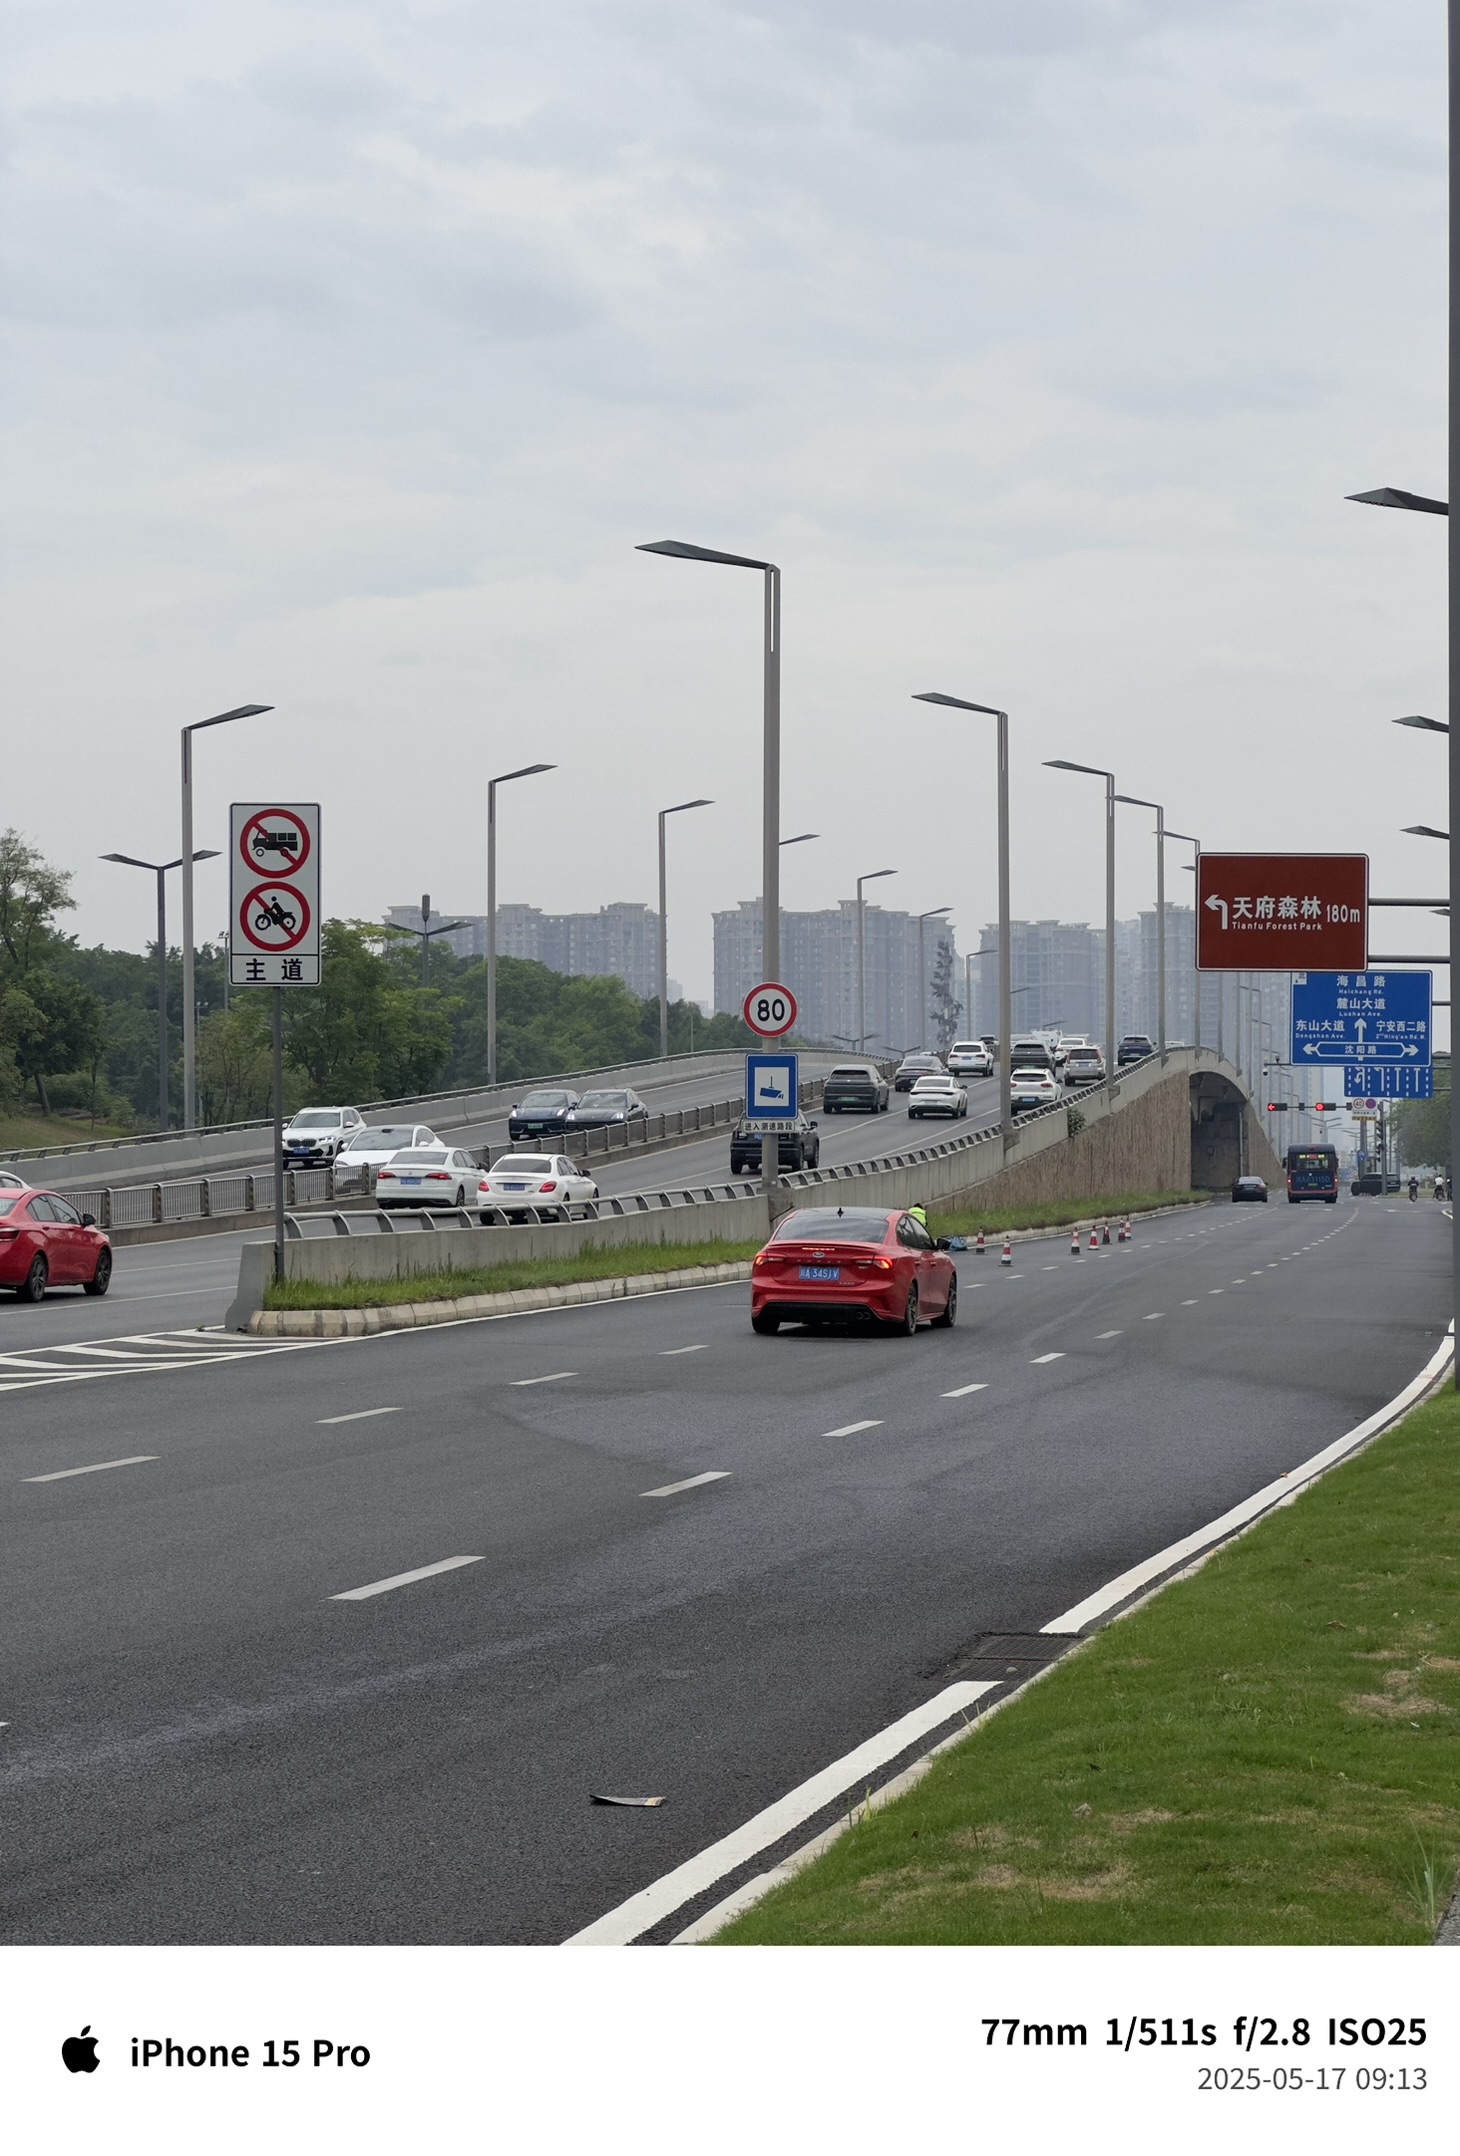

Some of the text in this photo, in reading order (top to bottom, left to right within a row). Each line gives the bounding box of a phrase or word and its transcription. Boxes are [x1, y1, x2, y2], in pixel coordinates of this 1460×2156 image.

[1232, 896, 1361, 923] 天府森林 180m
[1232, 921, 1323, 930] Tianfu Forest Park
[245, 957, 304, 981] 主道
[1336, 975, 1386, 987] 海昌路
[1336, 997, 1386, 1010] 麓山大道
[757, 998, 785, 1022] 80
[1296, 1019, 1345, 1032] 东山大道
[1376, 1020, 1426, 1032] 宁安西二路
[1344, 1045, 1377, 1055] 沈阳路
[744, 1121, 793, 1131] 进入测速路段
